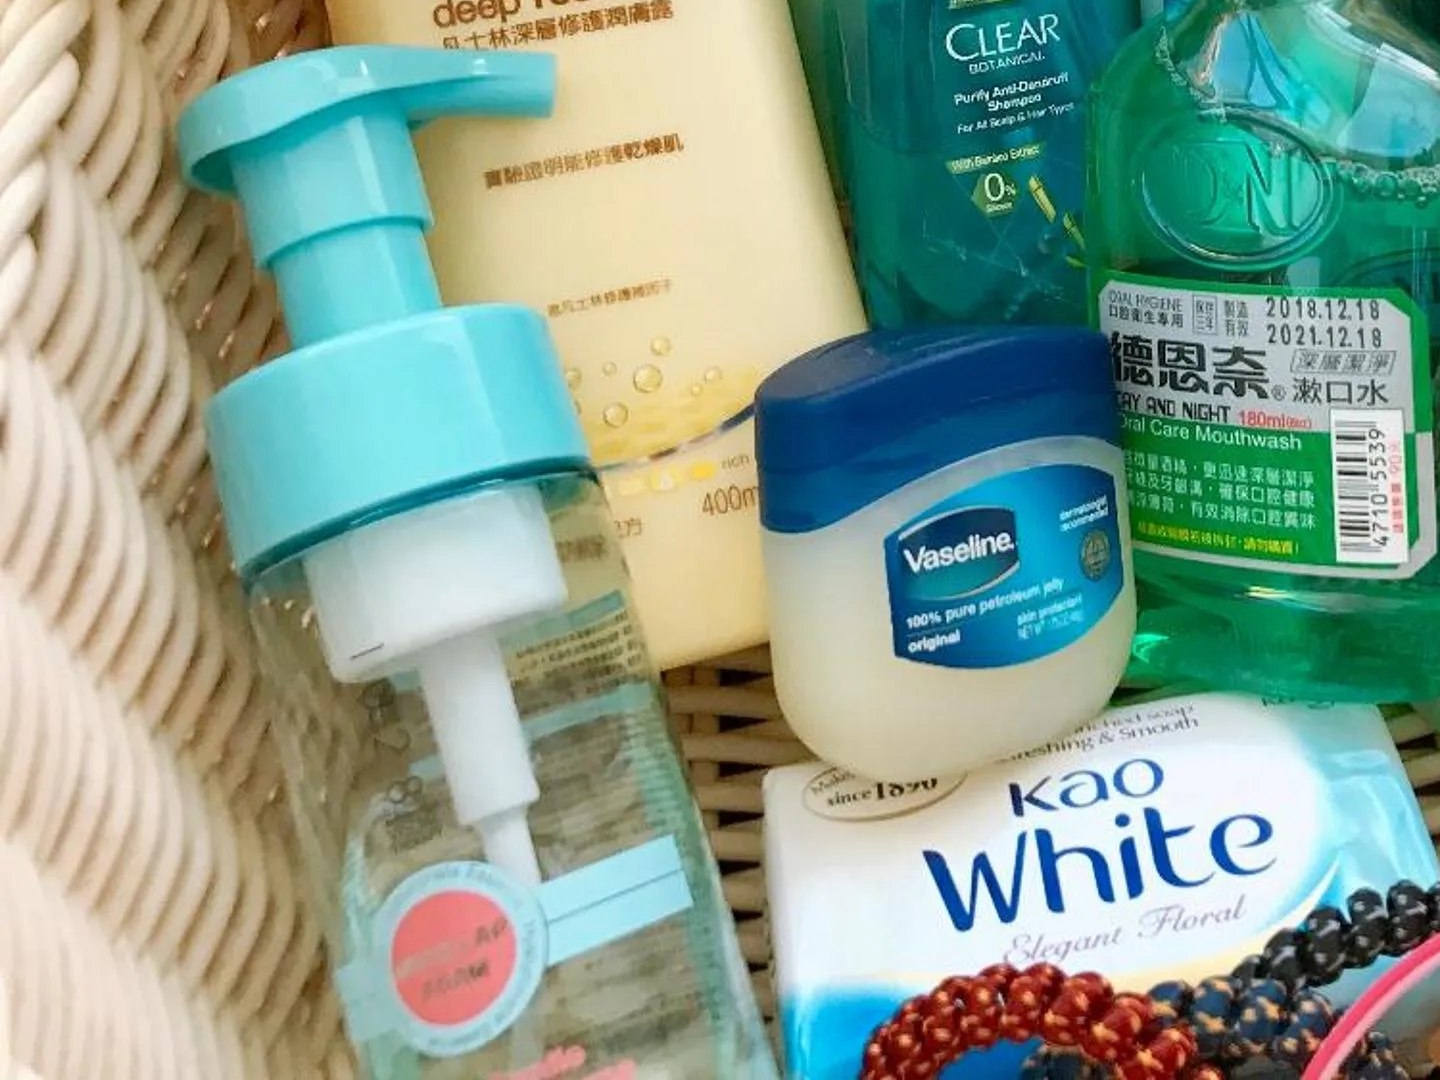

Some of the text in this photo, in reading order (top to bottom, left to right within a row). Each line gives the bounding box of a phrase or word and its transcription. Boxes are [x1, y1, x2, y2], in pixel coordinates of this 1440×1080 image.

[945, 13, 1060, 62] CLEAR
[968, 51, 1046, 75] BOTANICAL
[987, 92, 1042, 113] Shampoo
[1266, 296, 1380, 320] 2018.12.18
[1267, 324, 1383, 349] 2021.12.18
[1111, 331, 1270, 400] 德恩奈
[1292, 376, 1389, 405] 漱口水
[1146, 396, 1176, 418] AND
[1182, 401, 1231, 424] NIGHT
[1150, 419, 1190, 442] Care
[1195, 424, 1303, 451] Mouthwash
[701, 483, 758, 517] 400m
[903, 531, 1016, 575] Vaseline
[905, 612, 942, 630] 100%
[945, 604, 977, 624] pure
[979, 583, 1041, 615] petroleum
[907, 629, 962, 654] original
[1099, 730, 1116, 745] &
[1119, 716, 1200, 741] Smooth
[826, 789, 873, 807] since
[922, 807, 1278, 934] White
[1002, 894, 1249, 967] Elegant Floral
